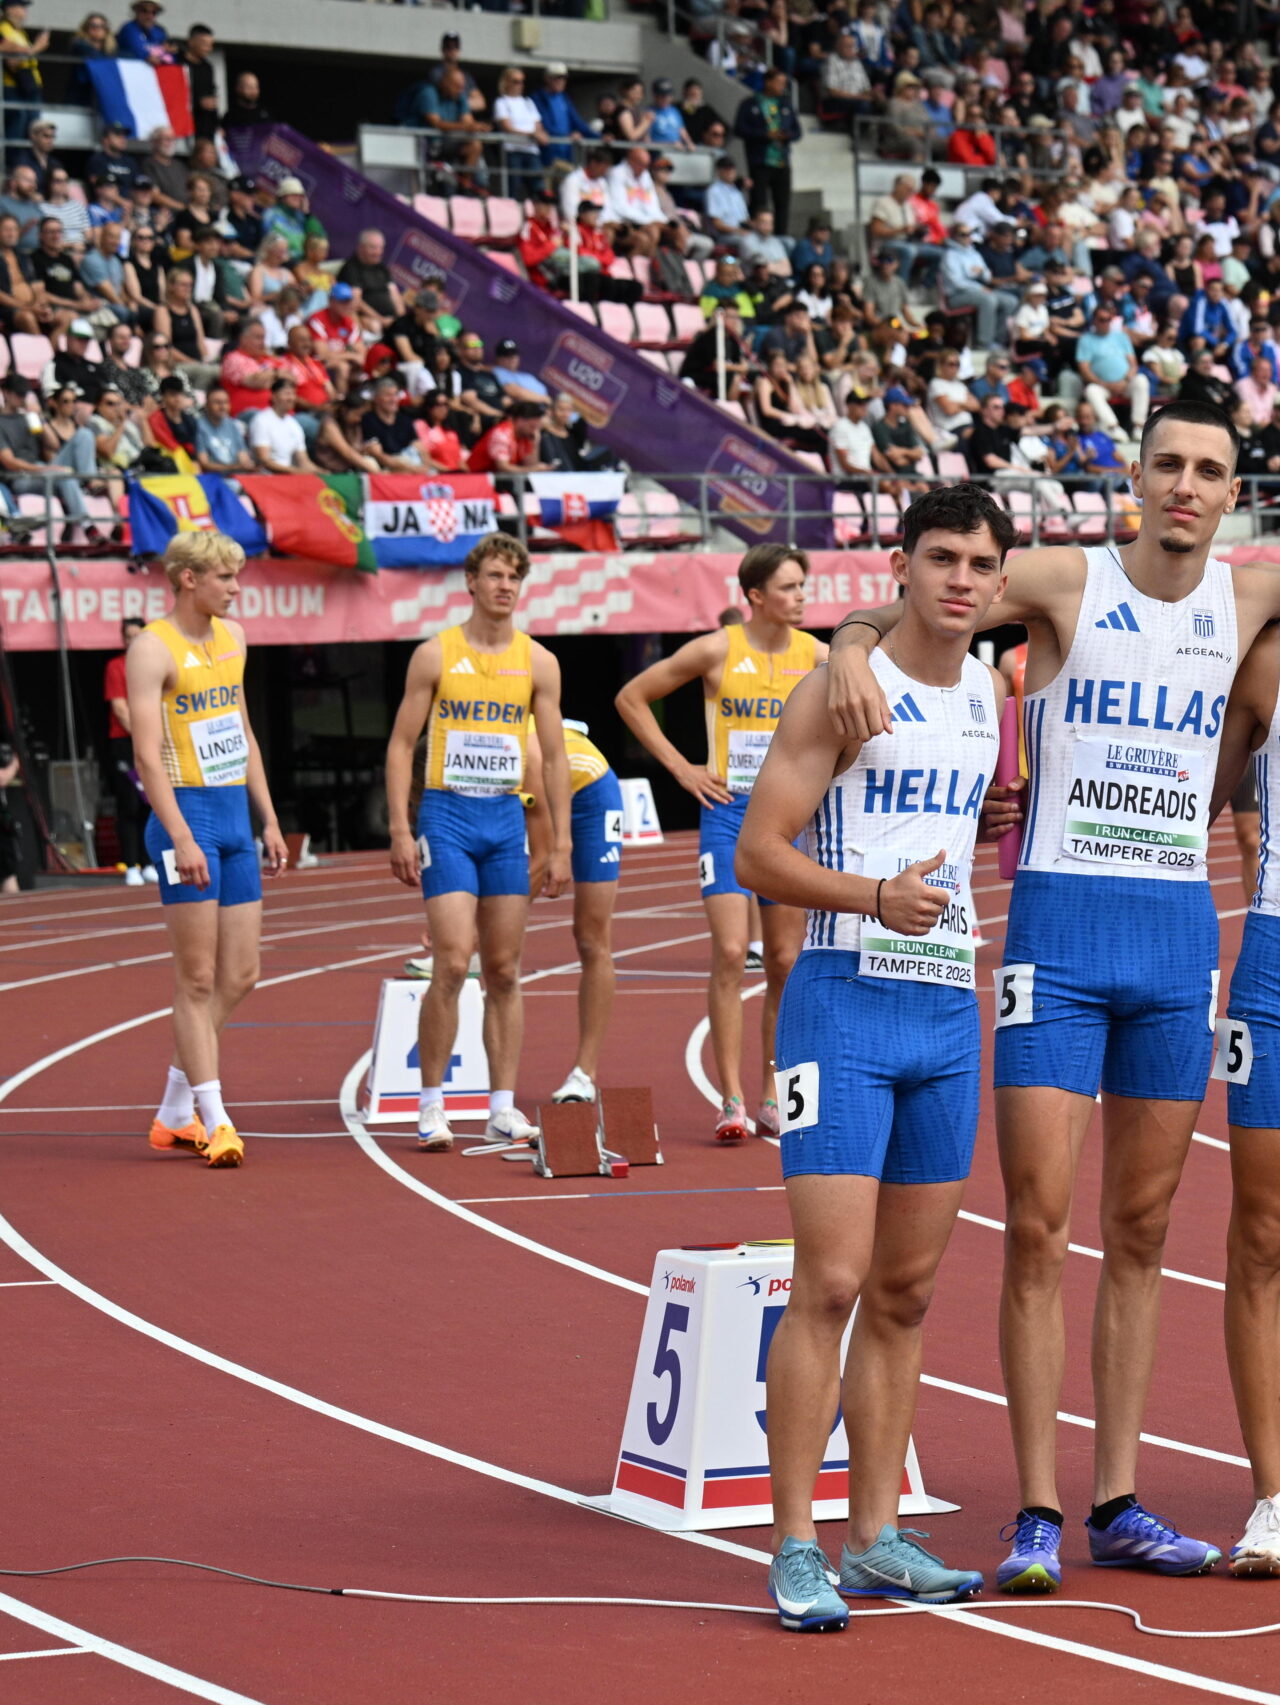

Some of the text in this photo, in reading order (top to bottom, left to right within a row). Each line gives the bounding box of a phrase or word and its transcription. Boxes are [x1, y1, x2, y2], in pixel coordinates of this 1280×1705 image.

[567, 358, 605, 391] U20
[383, 503, 488, 533] JA NA
[3, 588, 167, 622] TAMPERE
[1176, 647, 1223, 659] AEGEAN
[438, 699, 527, 724] SWEDEN
[720, 697, 784, 719] SWED
[1064, 678, 1226, 738] HELLAS
[444, 753, 518, 772] JANNERT
[1107, 744, 1178, 769] LE GRUYÈRE
[1109, 761, 1175, 777] SWITZERLAND
[863, 768, 985, 820] HELLA
[1068, 778, 1197, 822] ANDREADIS
[637, 793, 650, 825] 2
[612, 817, 621, 837] 4
[1102, 826, 1132, 839] RUN
[1071, 839, 1196, 867] TAMPERE 2025
[700, 861, 707, 880] 4
[895, 940, 925, 953] RUN
[868, 956, 971, 983] TAMPERE 2025
[1000, 973, 1017, 1018] 5
[1227, 1029, 1244, 1074] 5
[787, 1073, 805, 1122] 5
[669, 1274, 696, 1294] polanik
[646, 1301, 690, 1446] 5
